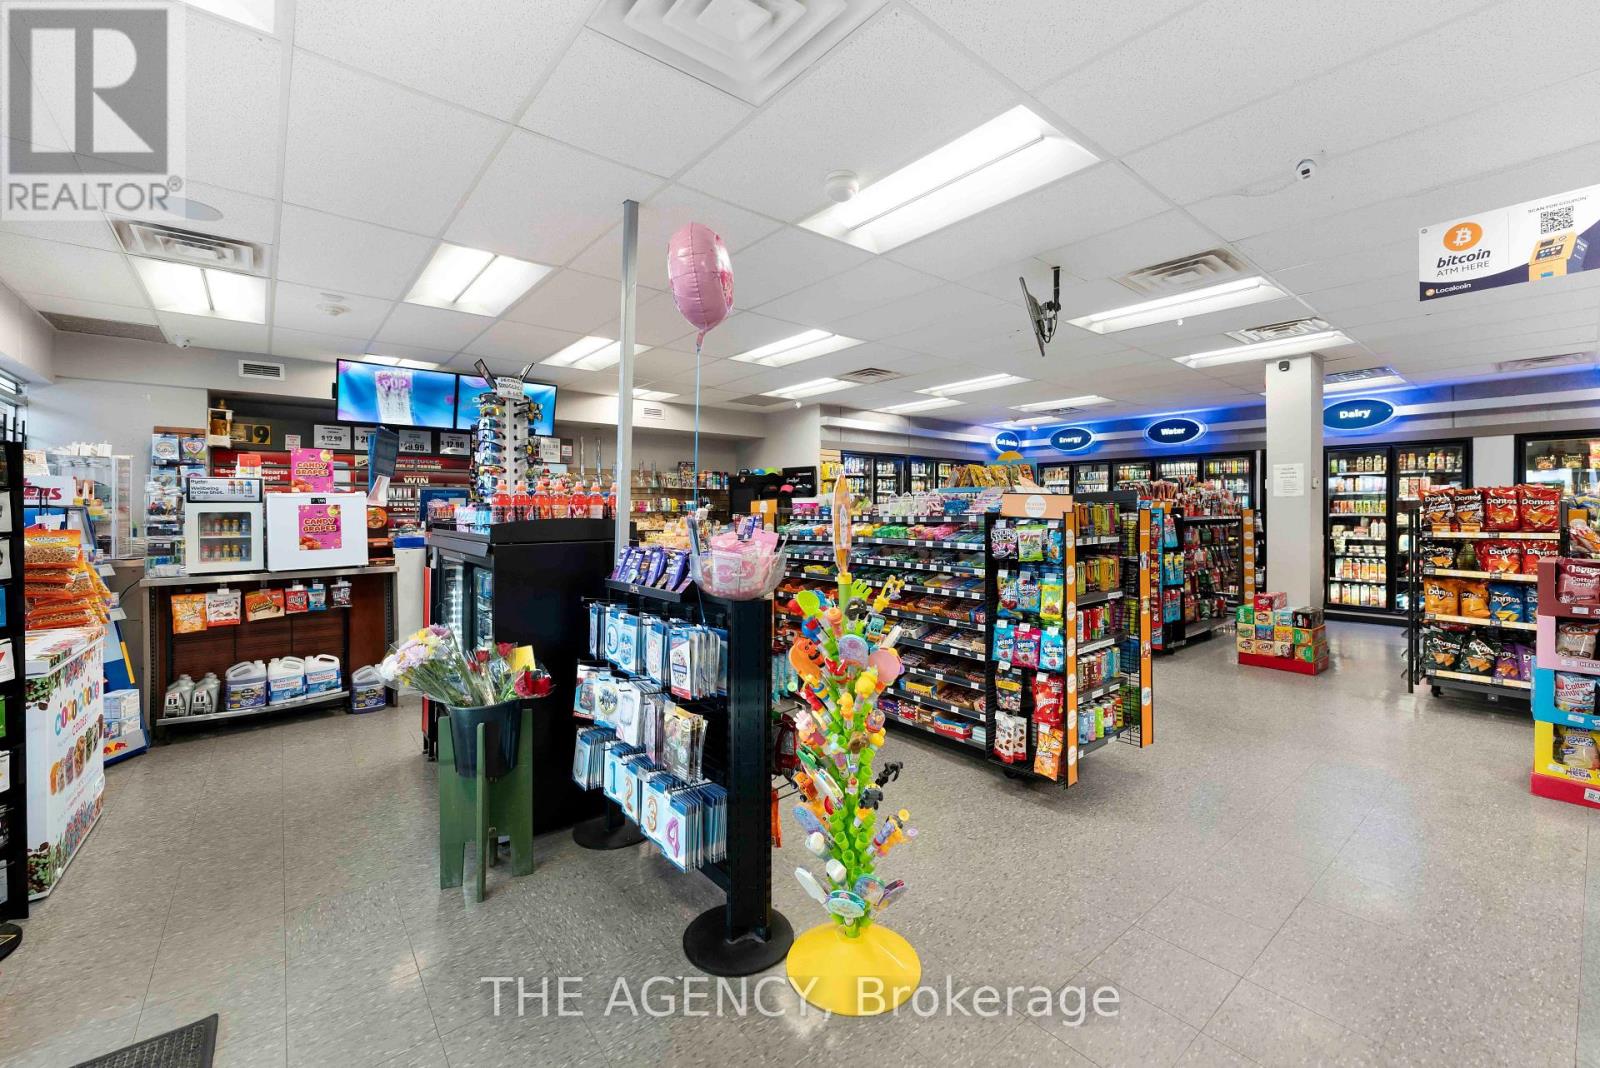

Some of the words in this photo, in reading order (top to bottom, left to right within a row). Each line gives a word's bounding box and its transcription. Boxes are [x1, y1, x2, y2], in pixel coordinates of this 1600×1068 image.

[1436, 249, 1491, 269] bitcoin
[1436, 265, 1459, 278] ATM
[1460, 260, 1490, 273] HERE
[1435, 282, 1472, 295] Localcoin
[1339, 408, 1371, 420] Dairy
[1160, 426, 1185, 436] Water
[1059, 435, 1082, 445] Energy
[297, 462, 328, 470] CANDY
[403, 475, 430, 484] WIN
[1455, 494, 1482, 502] Doritos
[1522, 498, 1555, 506] Doritos
[304, 517, 335, 525] CANDY
[303, 524, 337, 532] GRAPES
[1492, 595, 1521, 604] Doritos
[1432, 637, 1460, 649] Doritos
[1564, 681, 1591, 691] Cotton
[1565, 769, 1592, 780] MEGA
